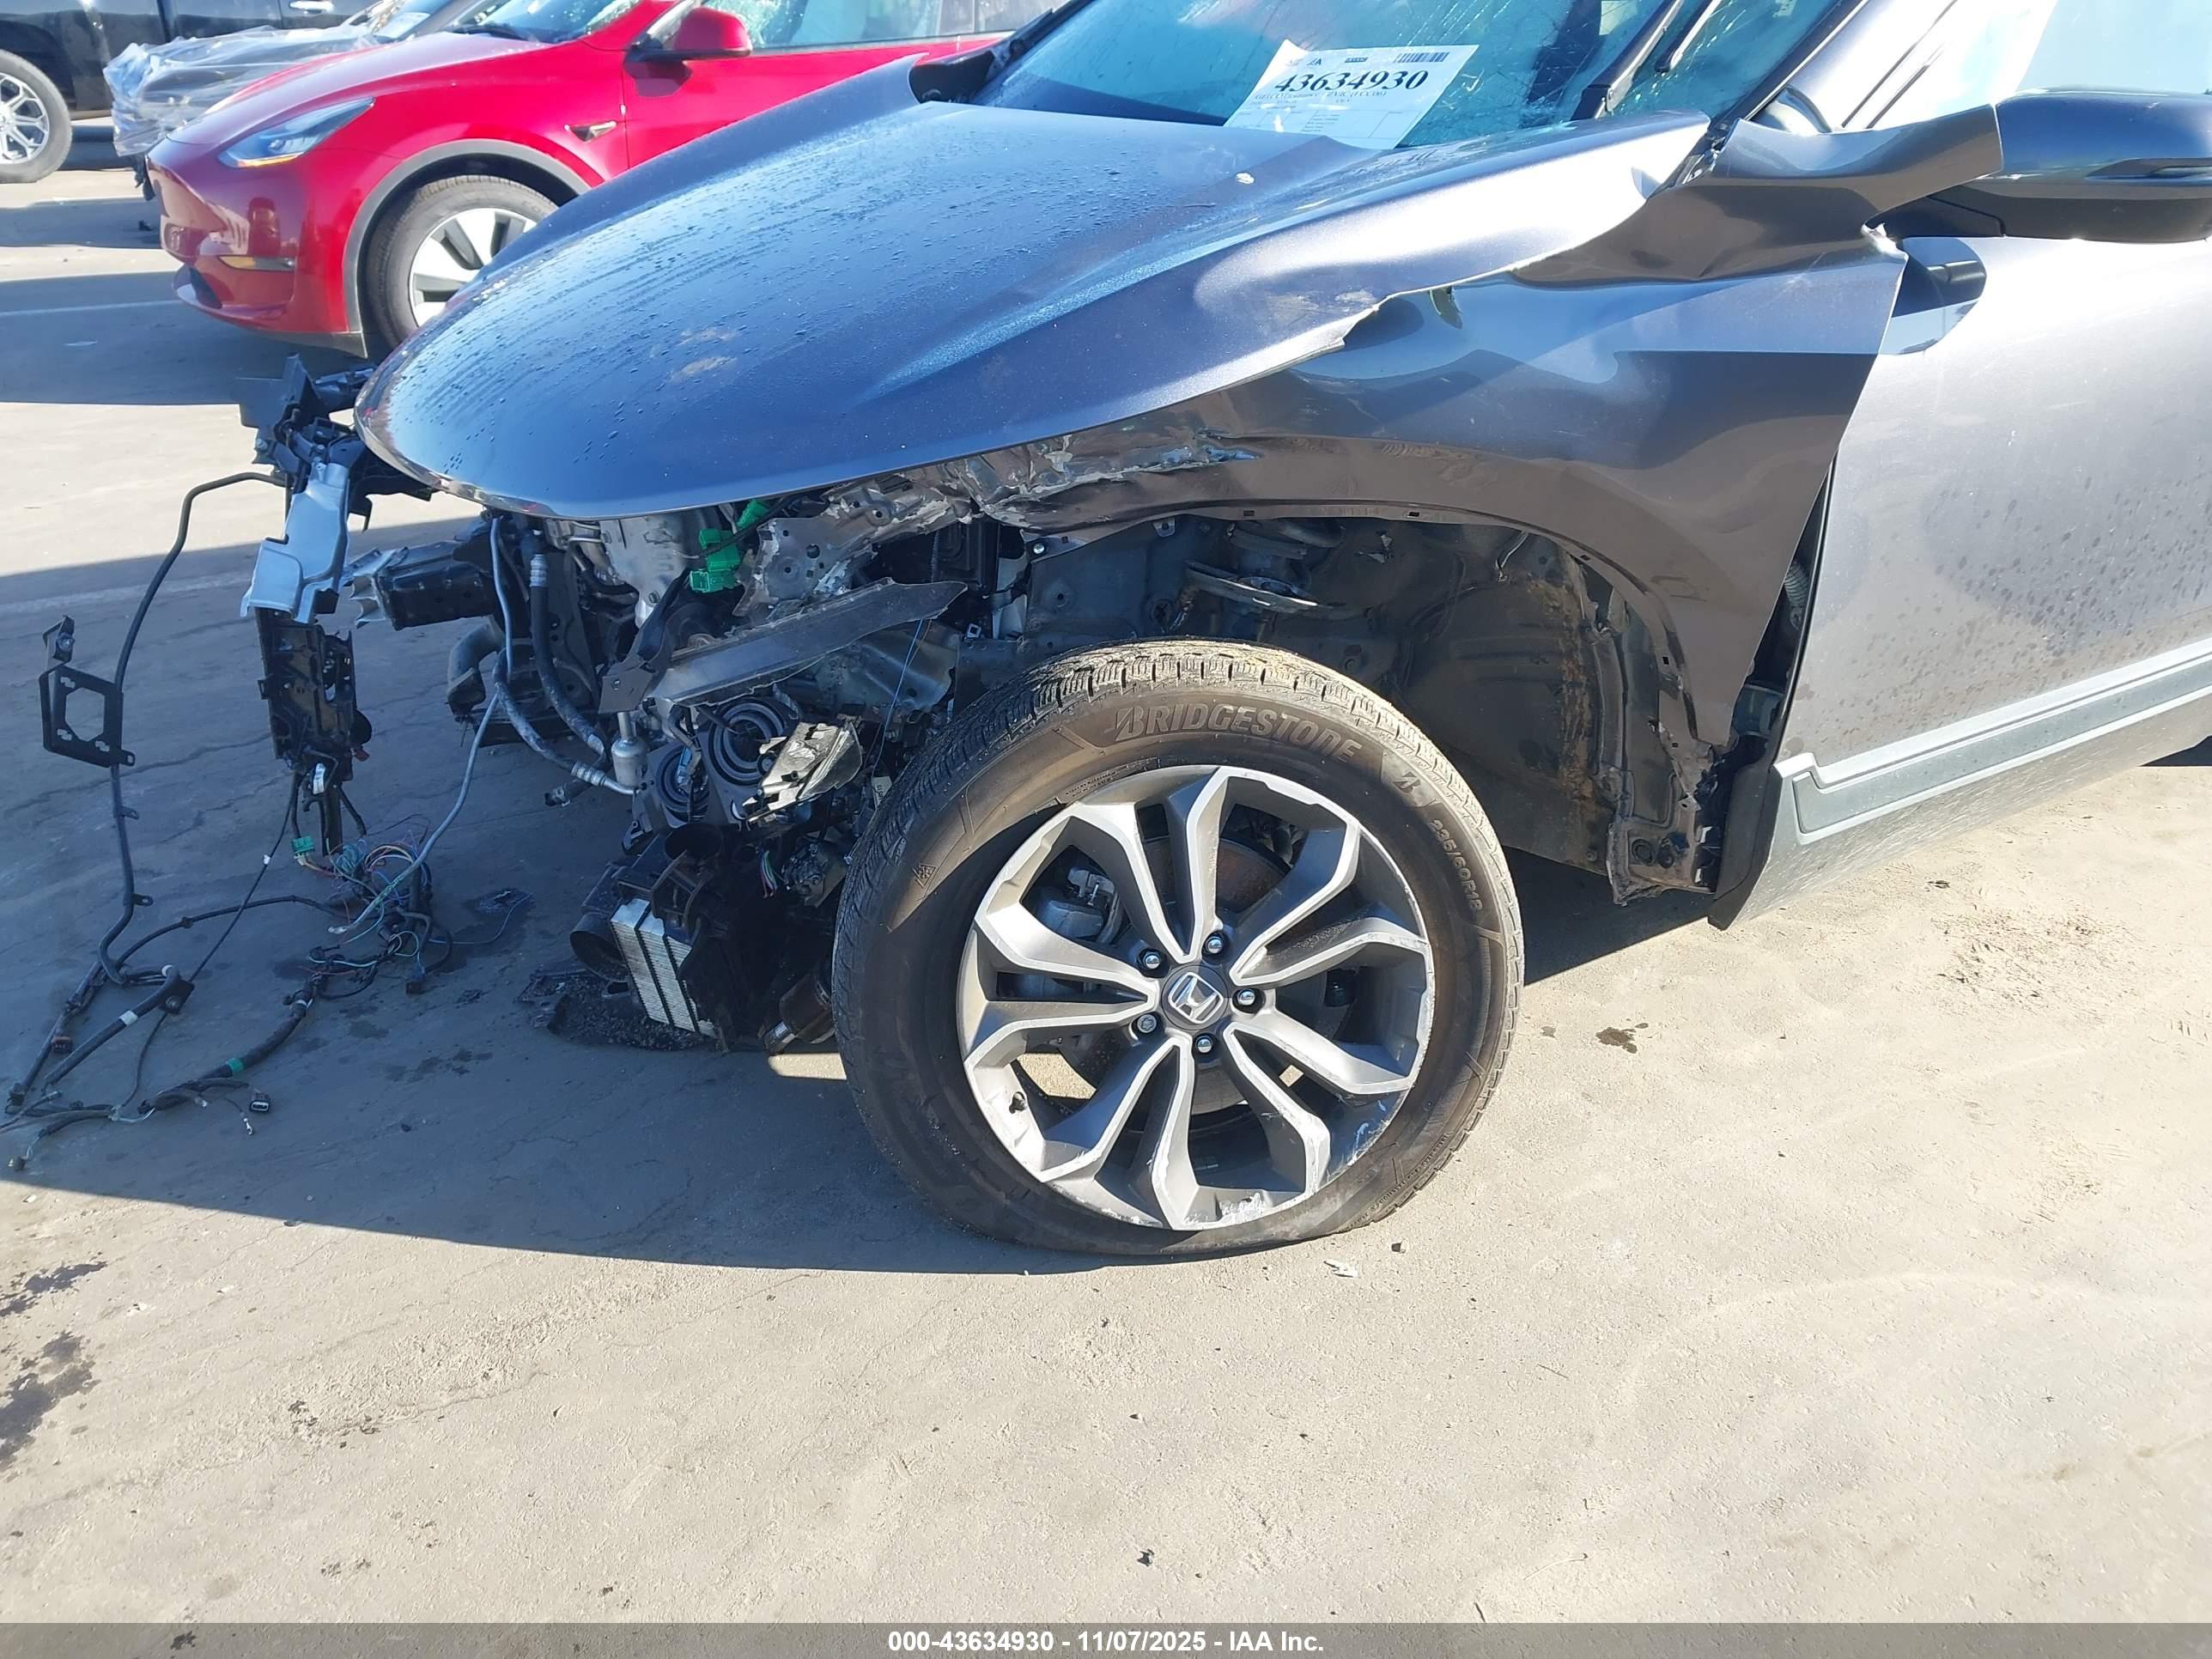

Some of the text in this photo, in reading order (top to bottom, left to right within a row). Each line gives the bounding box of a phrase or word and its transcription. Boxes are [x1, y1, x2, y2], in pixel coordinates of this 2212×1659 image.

[1274, 69, 1429, 93] 43634930
[1115, 702, 1363, 763] BRIDGESTONE
[1428, 818, 1484, 911] 235/60R18
